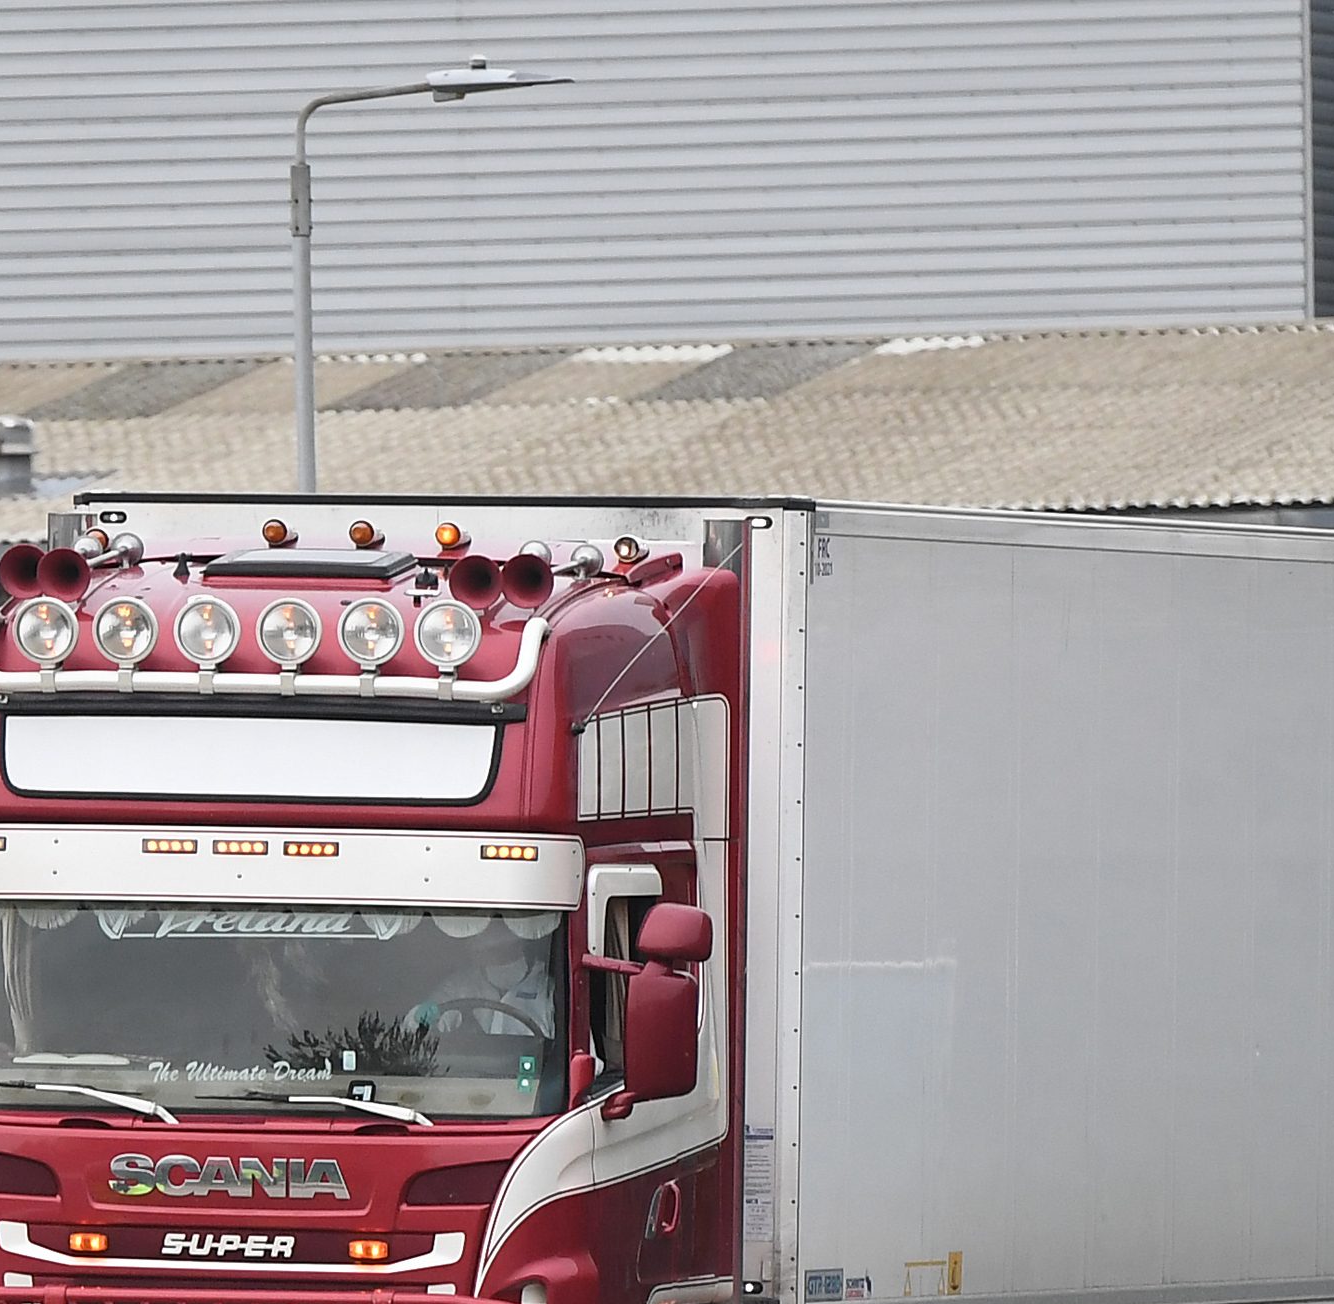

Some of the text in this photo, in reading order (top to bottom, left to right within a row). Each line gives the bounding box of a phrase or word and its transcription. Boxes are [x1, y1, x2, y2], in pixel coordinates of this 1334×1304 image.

[148, 1059, 333, 1084] The Ultimate Dream
[108, 1152, 351, 1200] SCANIA
[161, 1232, 295, 1259] SUPER
